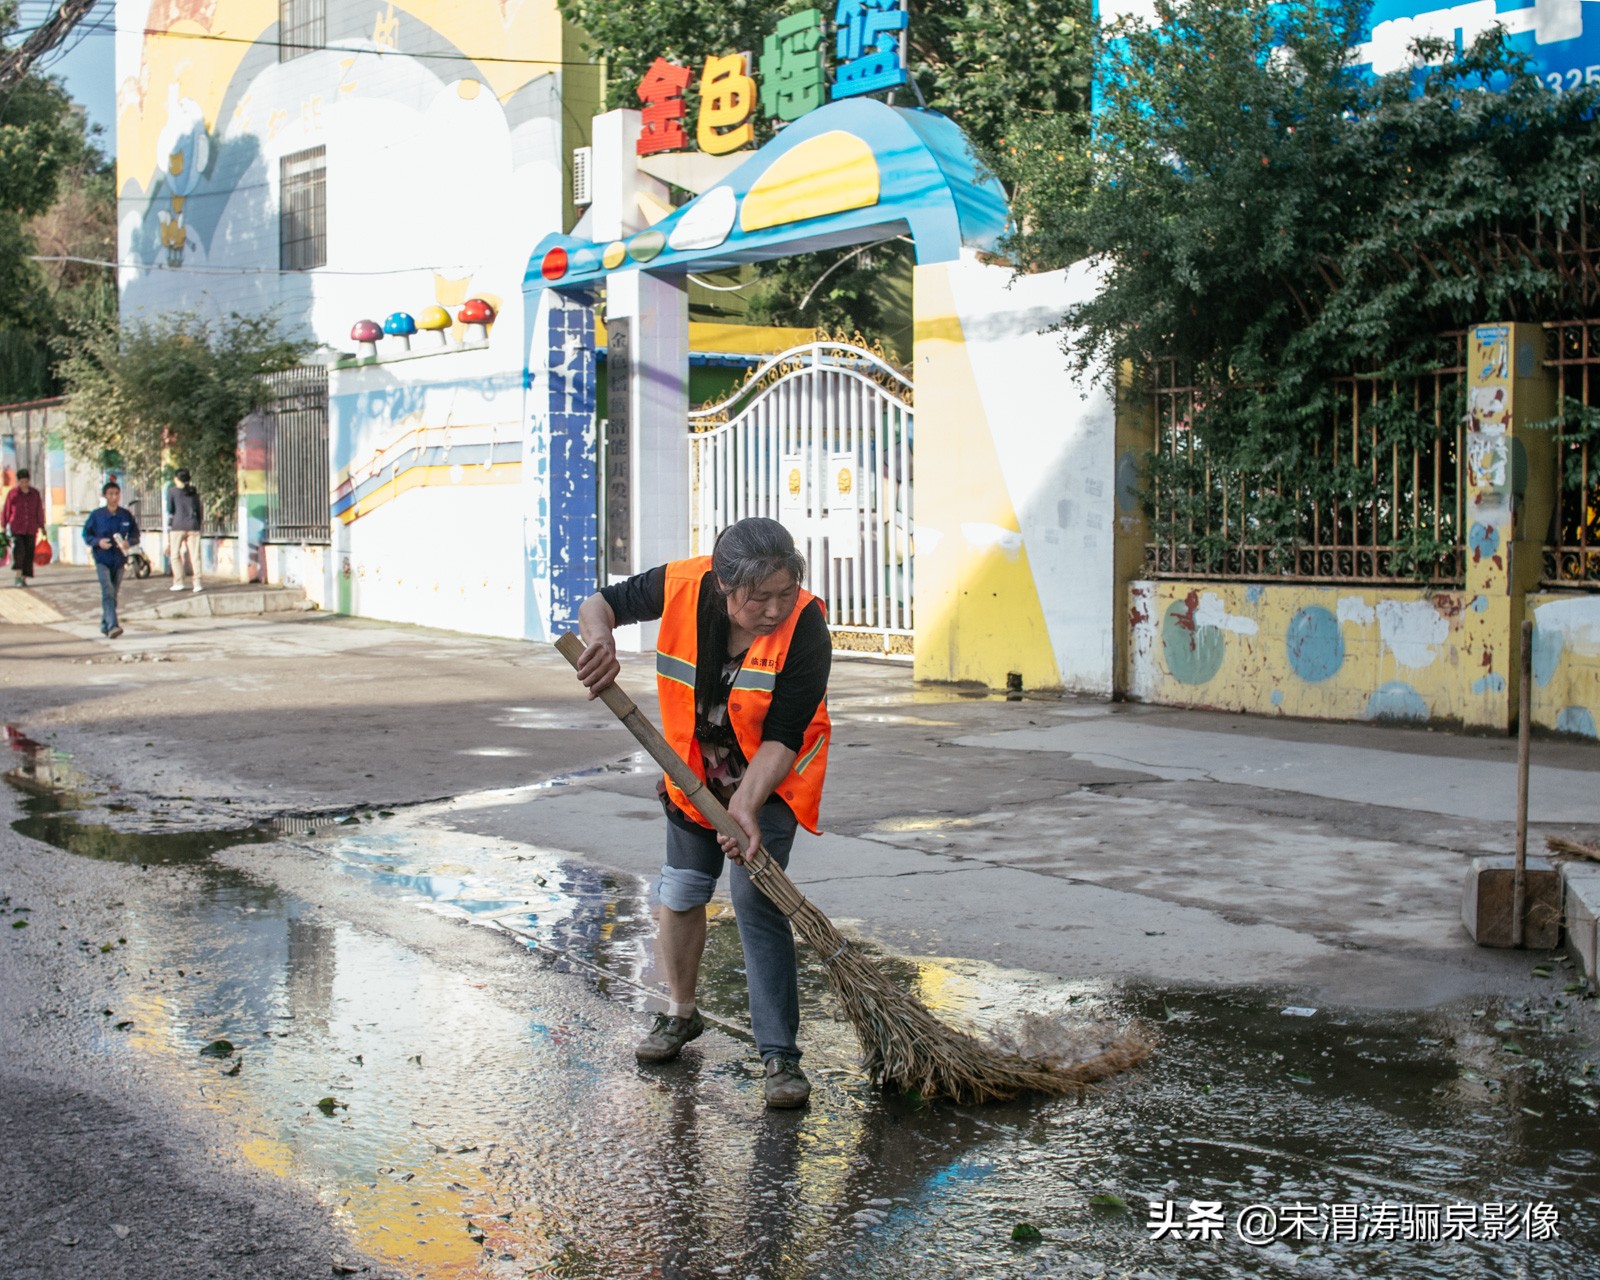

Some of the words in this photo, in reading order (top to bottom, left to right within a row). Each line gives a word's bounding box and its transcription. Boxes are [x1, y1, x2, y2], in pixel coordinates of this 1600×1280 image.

[636, 0, 909, 156] 金色摇篮
[750, 656, 779, 669] 临渭环
